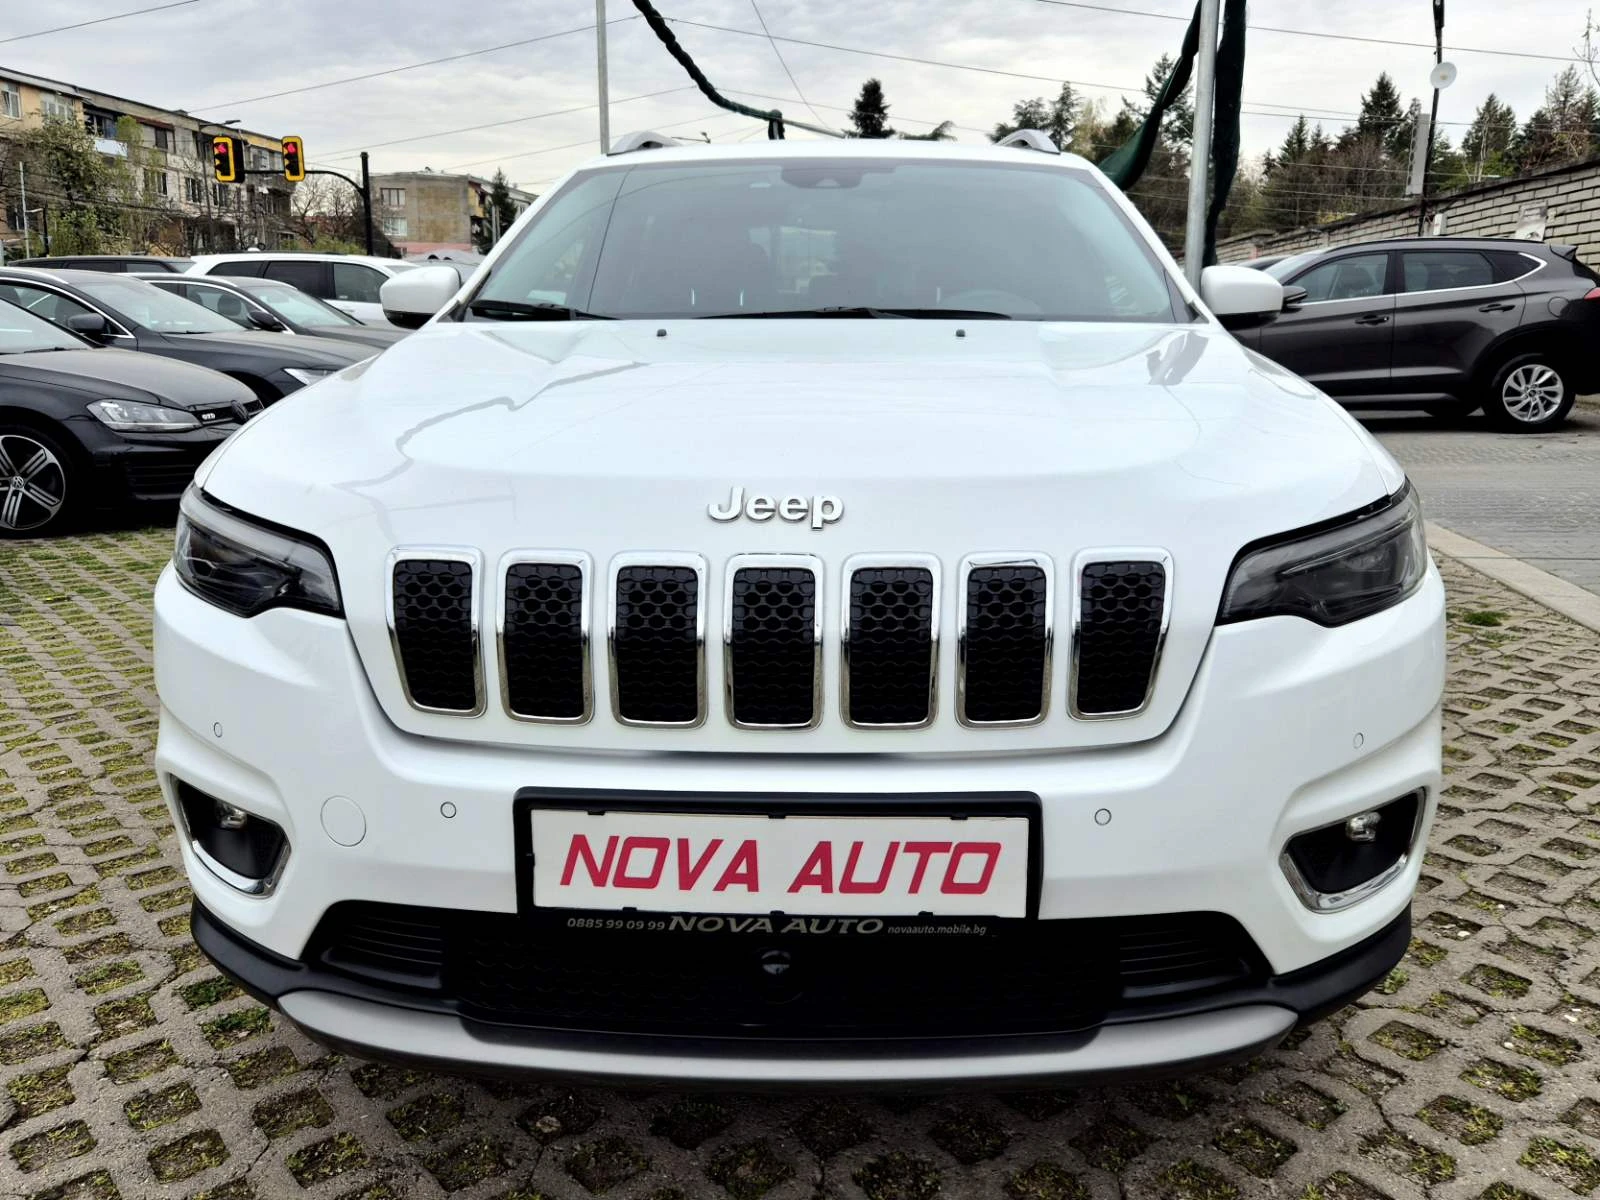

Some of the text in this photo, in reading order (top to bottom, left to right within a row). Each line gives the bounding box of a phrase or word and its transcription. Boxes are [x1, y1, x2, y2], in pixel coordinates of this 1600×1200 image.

[707, 486, 844, 530] Jeep
[560, 834, 1001, 894] NOVA AUTO
[567, 916, 987, 936] 0885 99 09 99 NOVA AUTO novaauto.mobile.bg
